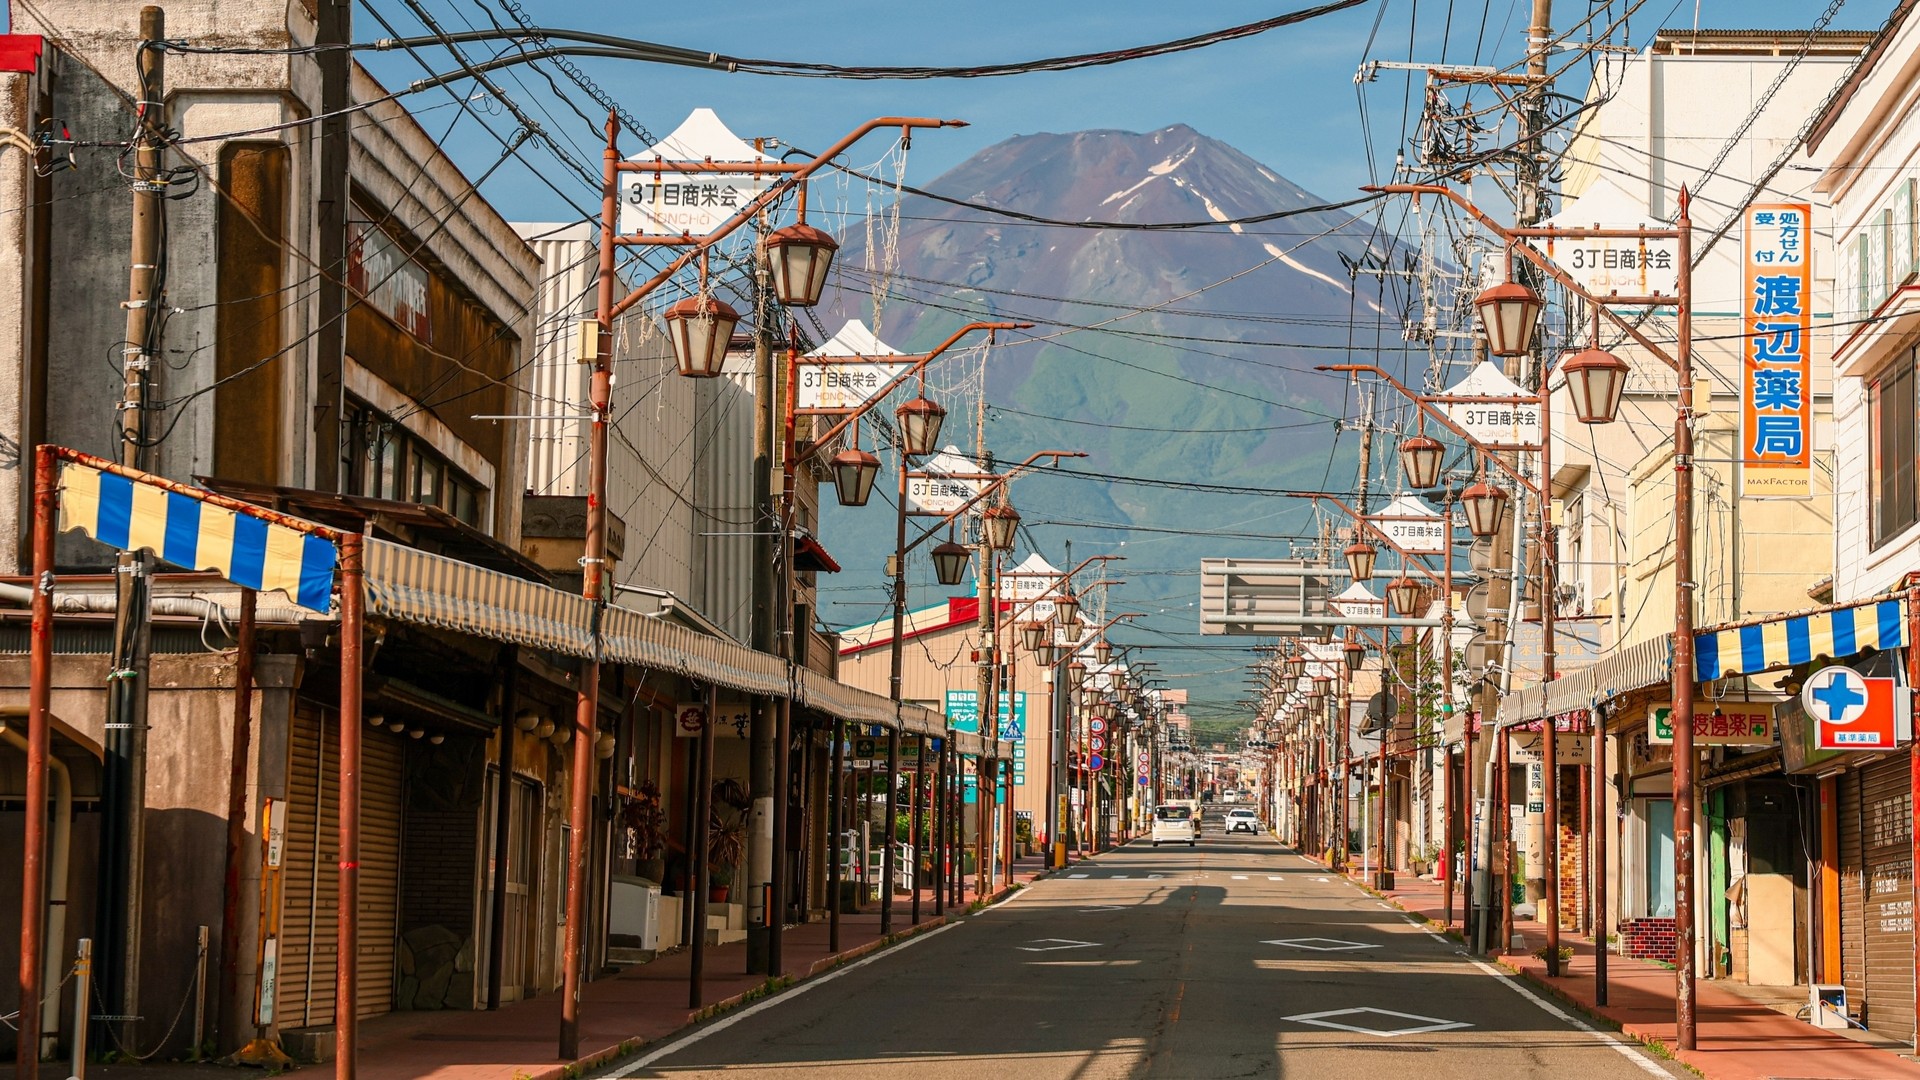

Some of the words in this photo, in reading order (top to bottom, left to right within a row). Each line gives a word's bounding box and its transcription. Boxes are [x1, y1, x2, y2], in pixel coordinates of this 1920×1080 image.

[629, 182, 738, 208] 3丁目商栄会
[646, 212, 710, 225] HONCHO
[1779, 212, 1800, 263] 処方せん
[1572, 248, 1672, 270] 3丁目商栄会
[1753, 275, 1802, 456] 渡辺薬局
[803, 371, 878, 389] 3丁目商栄会
[1466, 410, 1536, 426] 3丁目商栄会
[912, 483, 969, 498] 3丁目商栄会
[1392, 525, 1442, 537] 3丁目商栄会
[1838, 733, 1878, 742] 基準薬局
